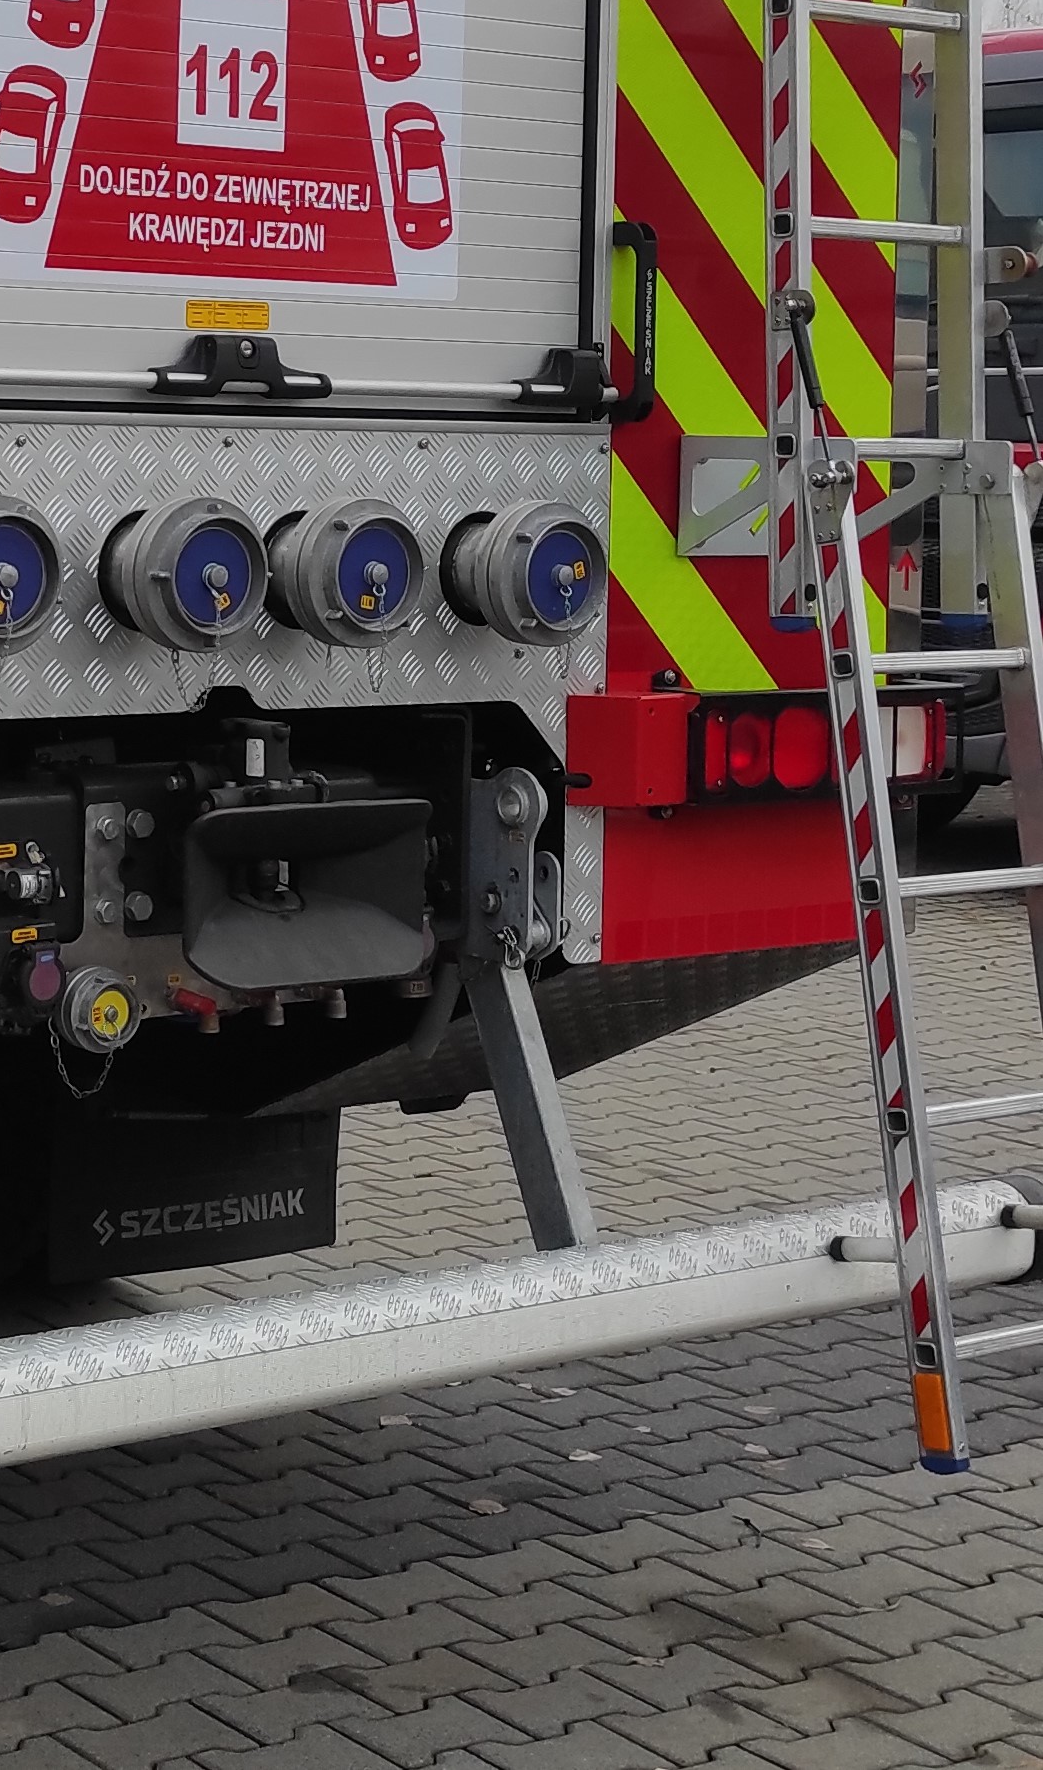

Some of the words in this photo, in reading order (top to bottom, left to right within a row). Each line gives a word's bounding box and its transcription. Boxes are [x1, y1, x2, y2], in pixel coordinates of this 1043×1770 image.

[185, 43, 279, 122] 112
[79, 161, 172, 199] DOJEDŹ
[176, 171, 208, 201] DO
[213, 174, 371, 215] ZEWNĘTRZNEJ
[128, 212, 245, 253] KRAWĘDZI
[249, 220, 326, 253] JEZDNI
